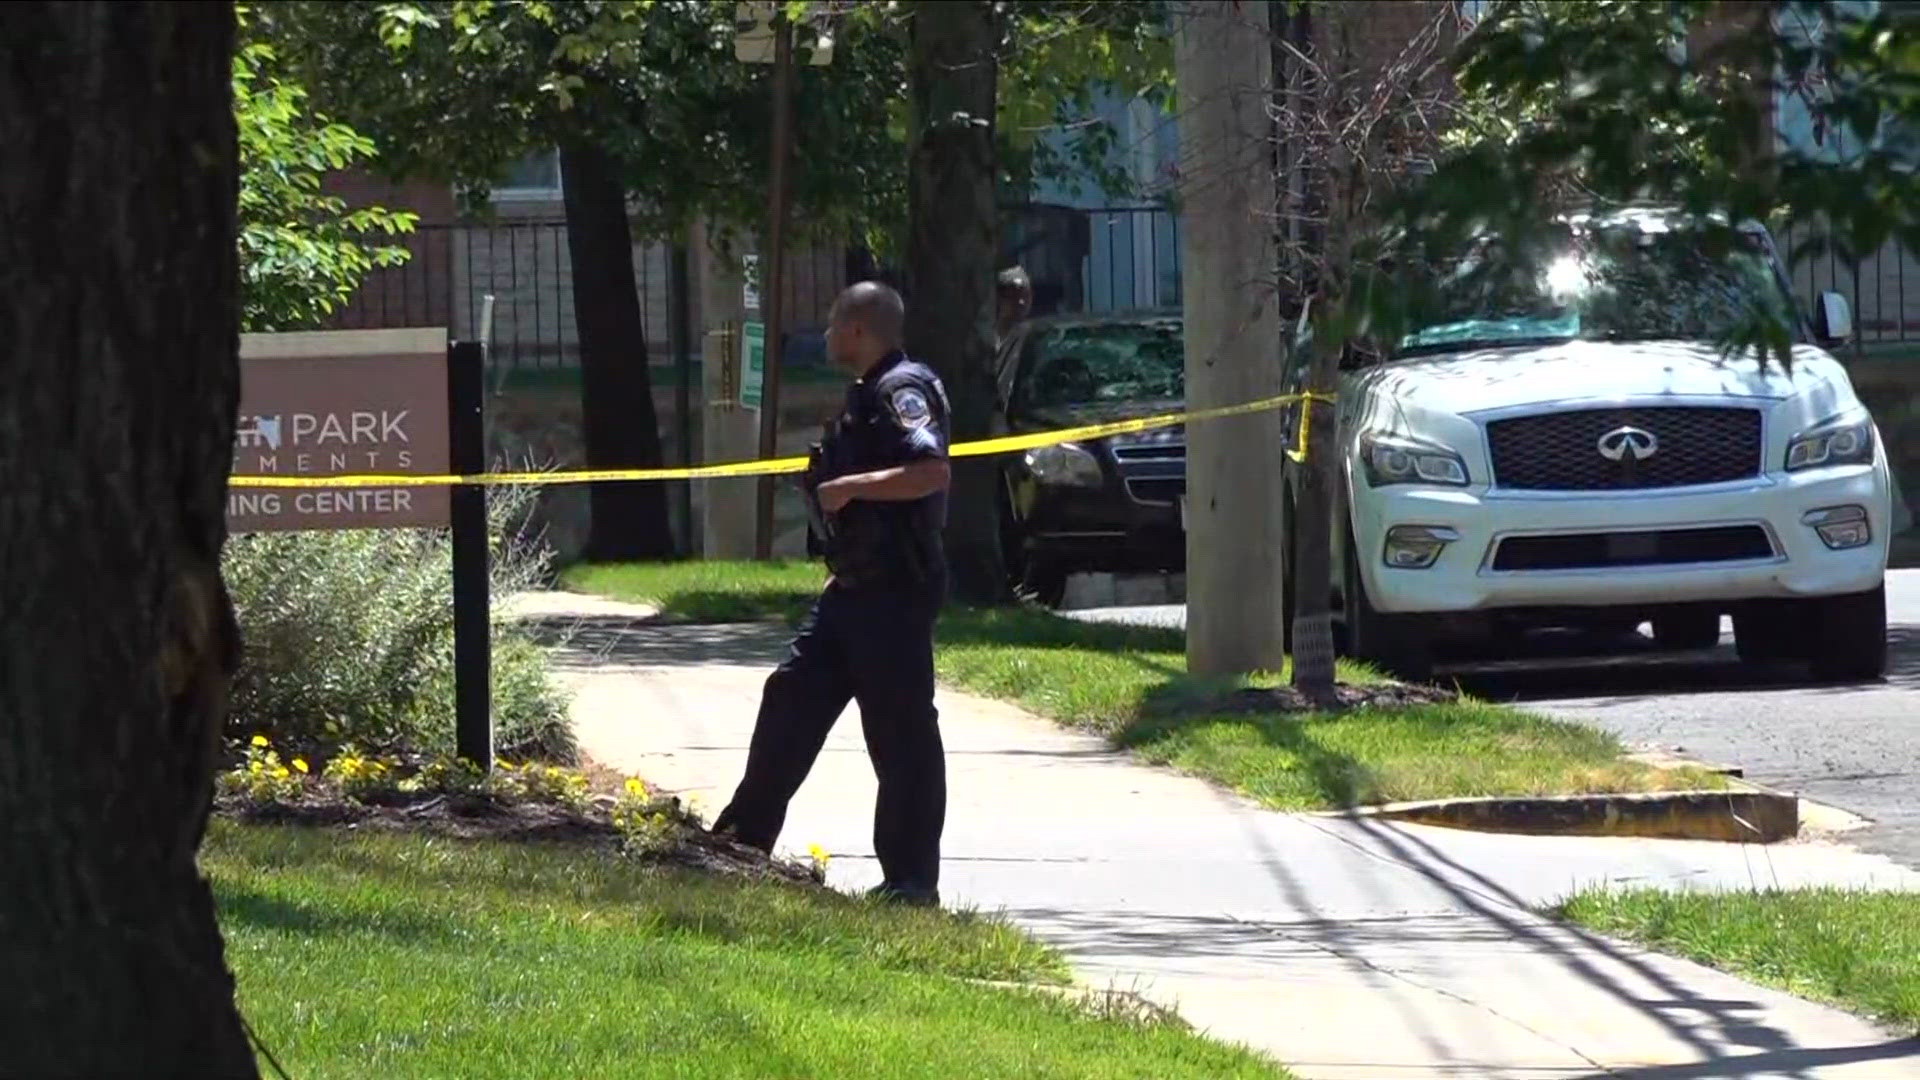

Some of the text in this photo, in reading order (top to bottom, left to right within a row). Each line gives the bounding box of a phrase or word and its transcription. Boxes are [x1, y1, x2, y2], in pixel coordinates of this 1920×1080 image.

[292, 410, 408, 445] PARK
[227, 489, 411, 516] ING CENTER
